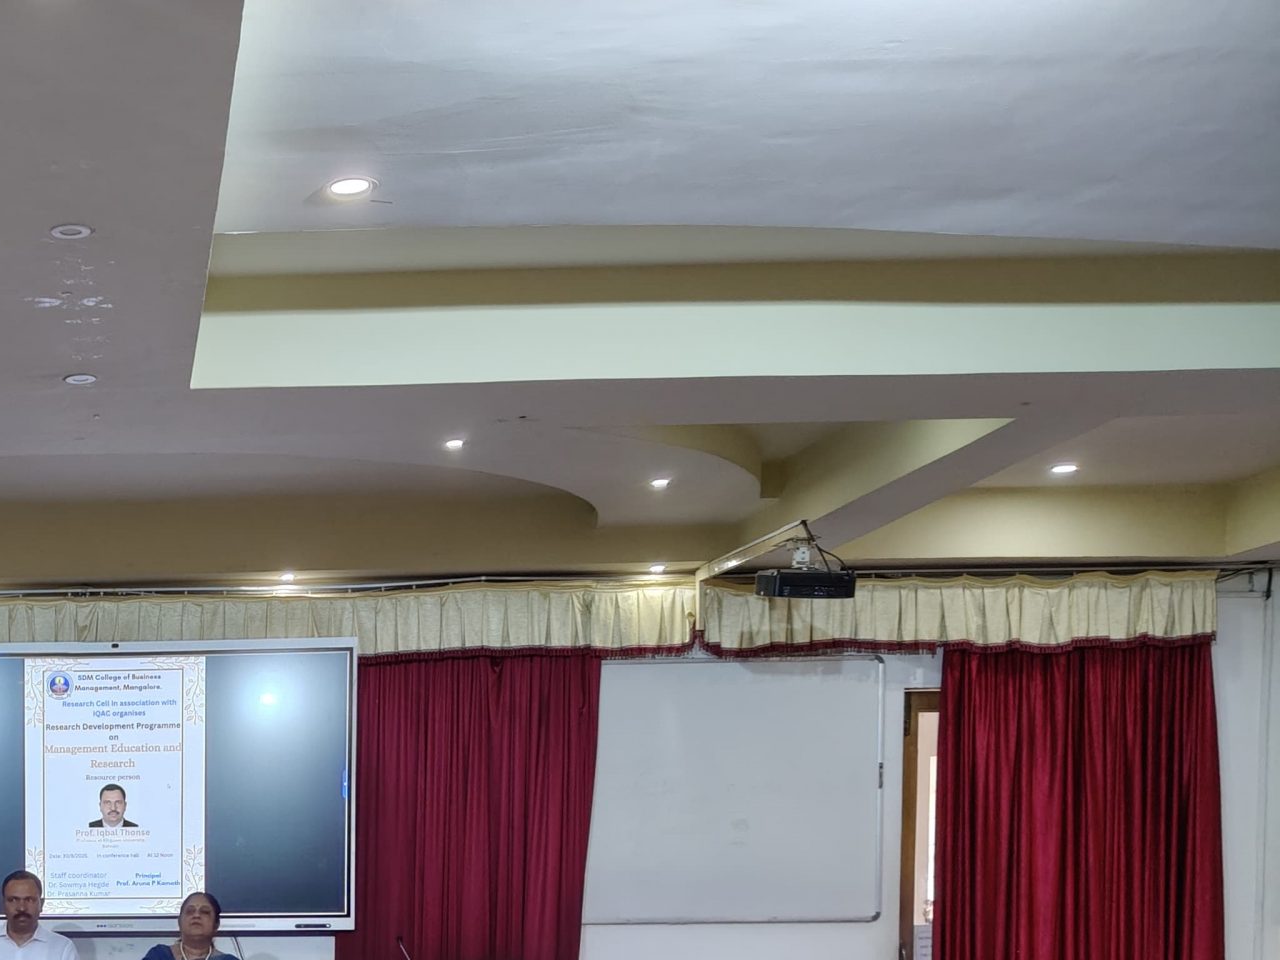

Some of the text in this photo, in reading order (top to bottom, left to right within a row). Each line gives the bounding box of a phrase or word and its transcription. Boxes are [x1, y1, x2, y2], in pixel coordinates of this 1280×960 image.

[112, 710, 146, 718] organises
[83, 723, 134, 731] Development
[137, 722, 180, 730] Programme
[45, 743, 182, 755] Management Education and
[91, 759, 135, 768] Research
[118, 774, 140, 782] person
[97, 829, 117, 838] Iqbal
